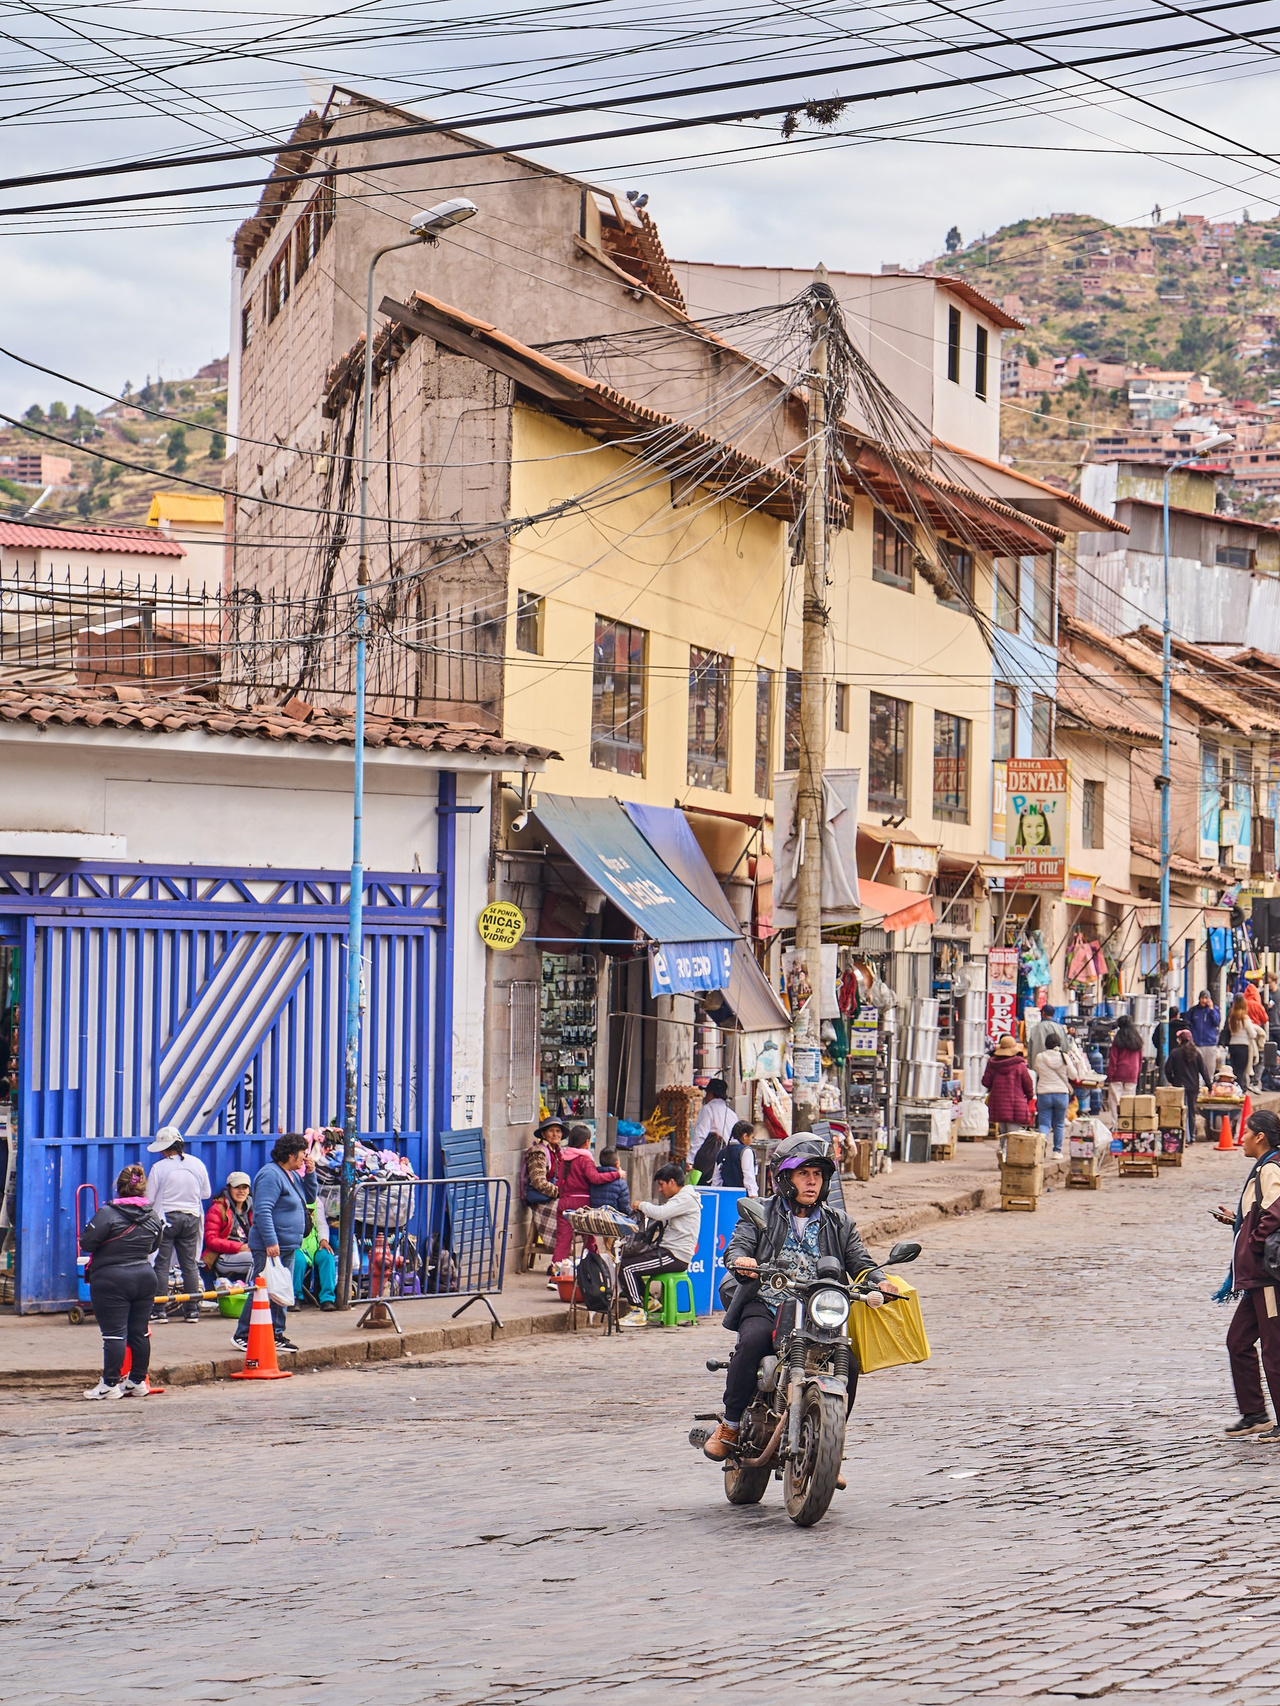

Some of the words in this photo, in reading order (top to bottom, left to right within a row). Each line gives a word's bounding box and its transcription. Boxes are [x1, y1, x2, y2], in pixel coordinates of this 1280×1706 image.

[1009, 760, 1042, 769] CLINICA
[1008, 771, 1066, 792] DENTAL
[497, 908, 518, 918] PONEN
[482, 914, 522, 930] MICAS
[483, 932, 514, 944] VIDRIO
